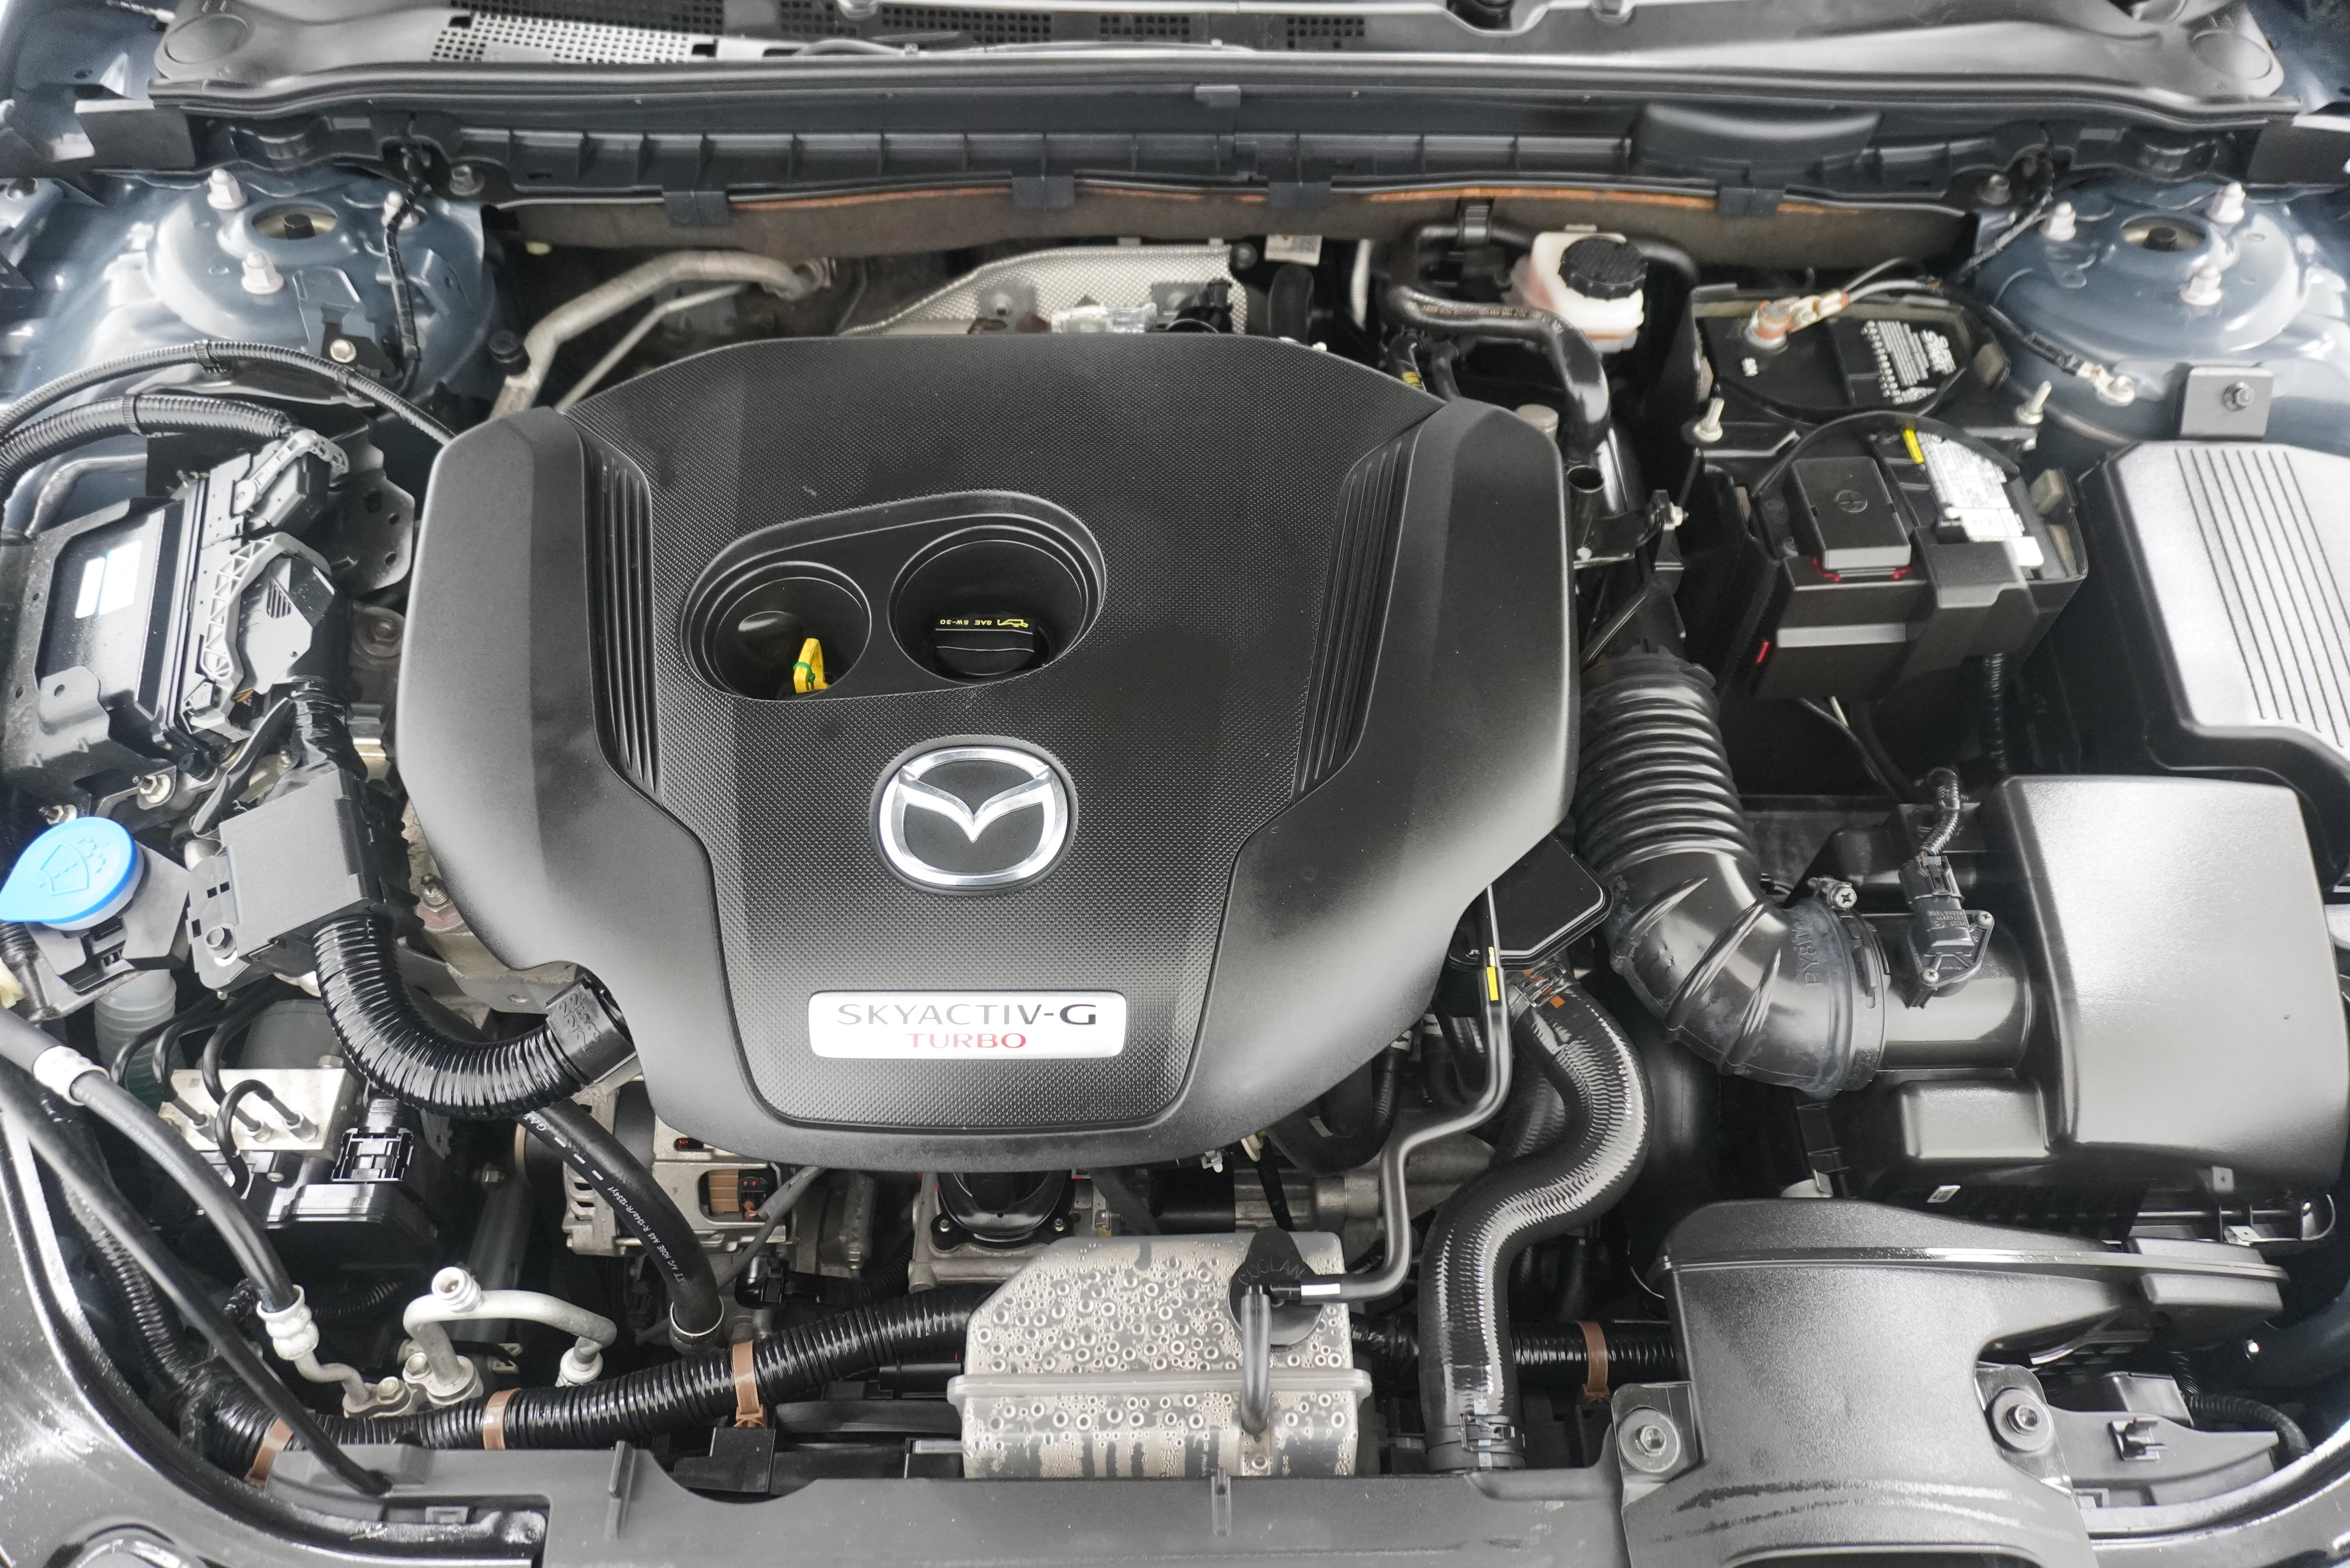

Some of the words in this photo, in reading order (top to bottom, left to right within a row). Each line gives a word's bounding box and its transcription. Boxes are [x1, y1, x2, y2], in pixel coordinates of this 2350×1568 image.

[837, 1003, 1097, 1025] SKYACTIV-G
[906, 1033, 1027, 1049] TURBO
[607, 1186, 651, 1232] R-134a/R-1234yf
[647, 1232, 661, 1243] A45
[657, 1244, 672, 1259] HOSE
[668, 1260, 679, 1270] A/C
[1238, 1256, 1306, 1286] COOLAN
